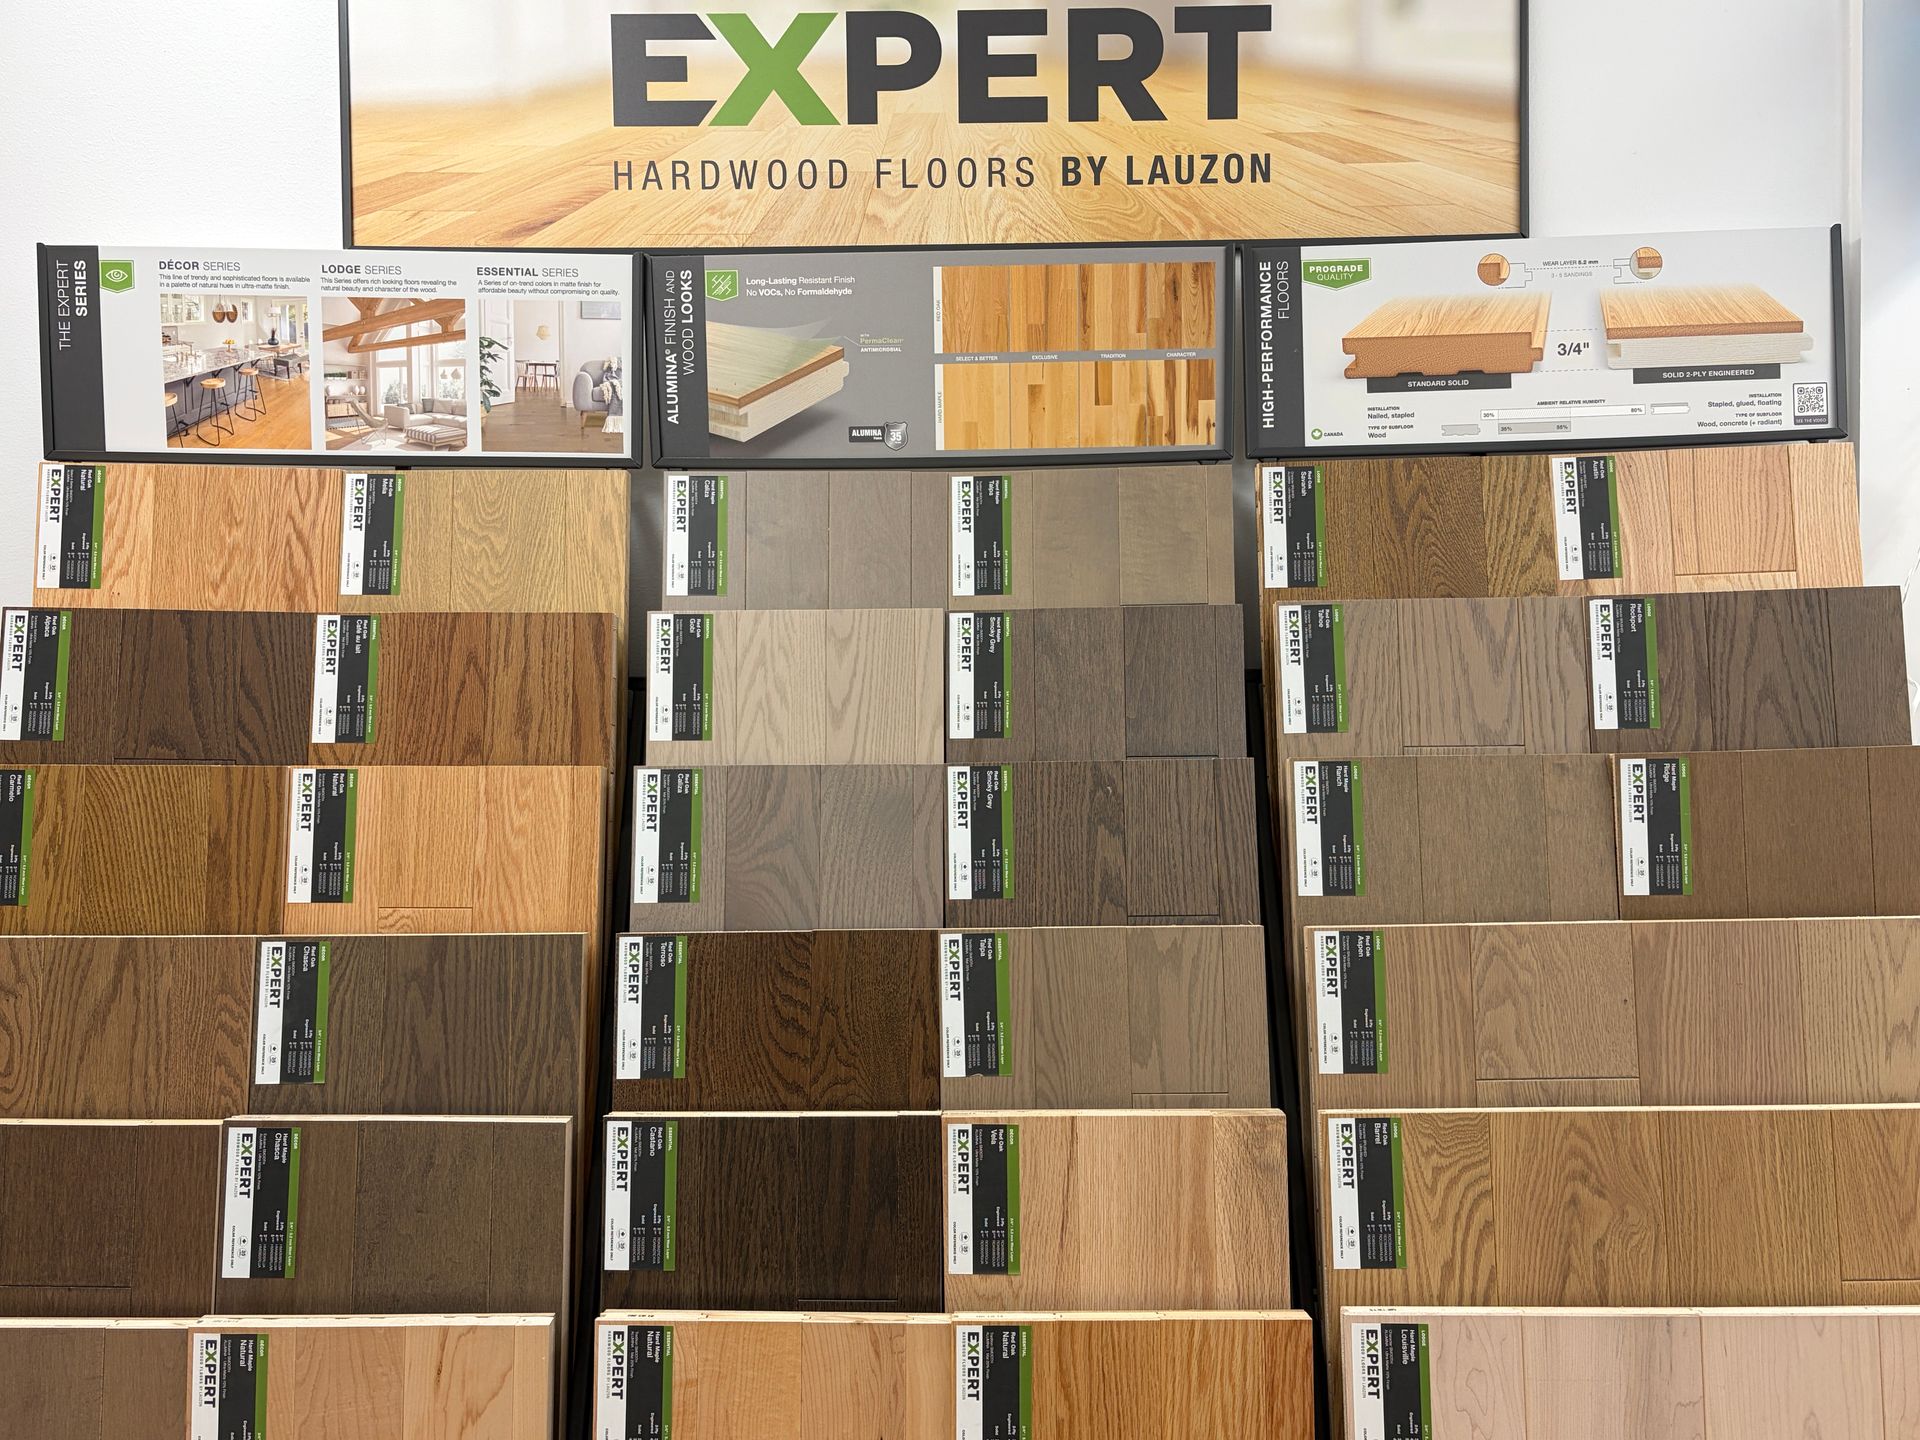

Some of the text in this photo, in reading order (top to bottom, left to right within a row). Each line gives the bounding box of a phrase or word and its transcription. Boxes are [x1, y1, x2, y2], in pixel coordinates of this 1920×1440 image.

[611, 4, 1272, 126] EXPERT
[613, 152, 1271, 191] HARDWOOD FLOORS BY LAUZON
[74, 260, 88, 317] SERIES
[159, 259, 241, 271] DÉCOR SERIES
[321, 265, 402, 275] LODGE SERIES
[477, 267, 579, 277] ESSENTIAL SERIES
[665, 270, 675, 294] AND
[746, 276, 855, 286] Long-Lasting Resistant Finish
[759, 289, 783, 297] VOCs,
[798, 288, 852, 296] Formaldehyde
[1277, 261, 1290, 319] FLOORS
[1310, 265, 1363, 273] PROGRADE
[56, 260, 71, 351] THE EXPERT
[664, 298, 677, 345] FINISH
[680, 269, 695, 376] WOOD LOOKS
[1259, 261, 1274, 428] HIGH-PERFORMANCE
[1557, 342, 1590, 356] 3/4"
[1408, 380, 1446, 388] STANDARD
[1709, 369, 1755, 377] ENGINEERED
[1391, 412, 1414, 420] stapled
[1736, 400, 1756, 408] glued,
[890, 432, 901, 441] 35
[50, 469, 61, 523] EXPERT
[353, 479, 364, 531] EXPERT
[676, 480, 686, 532] EXPERT
[962, 481, 971, 533] EXPERT
[1273, 471, 1283, 524] EXPERT
[1565, 462, 1576, 514] EXPERT
[12, 615, 25, 671] EXPERT
[326, 620, 337, 675] EXPERT
[356, 635, 360, 643] au
[661, 619, 670, 674] EXPERT
[962, 617, 971, 672] EXPERT
[1290, 610, 1300, 666] EXPERT
[1600, 604, 1612, 660] EXPERT
[301, 773, 312, 831] EXPERT
[647, 774, 657, 832] EXPERT
[957, 771, 968, 829] EXPERT
[1305, 766, 1317, 824] EXPERT
[1633, 764, 1644, 823] EXPERT
[270, 947, 282, 1008] EXPERT
[628, 942, 639, 1004] EXPERT
[949, 939, 960, 1001] EXPERT
[1326, 936, 1338, 997] EXPERT
[239, 1133, 253, 1198] EXPERT
[617, 1127, 628, 1191] EXPERT
[958, 1129, 969, 1194] EXPERT
[1341, 1124, 1354, 1188] EXPERT
[204, 1339, 217, 1408] EXPERT
[612, 1331, 624, 1399] EXPERT
[968, 1332, 979, 1401] EXPERT
[1366, 1329, 1380, 1399] EXPERT
[1401, 1330, 1409, 1365] Louisville
